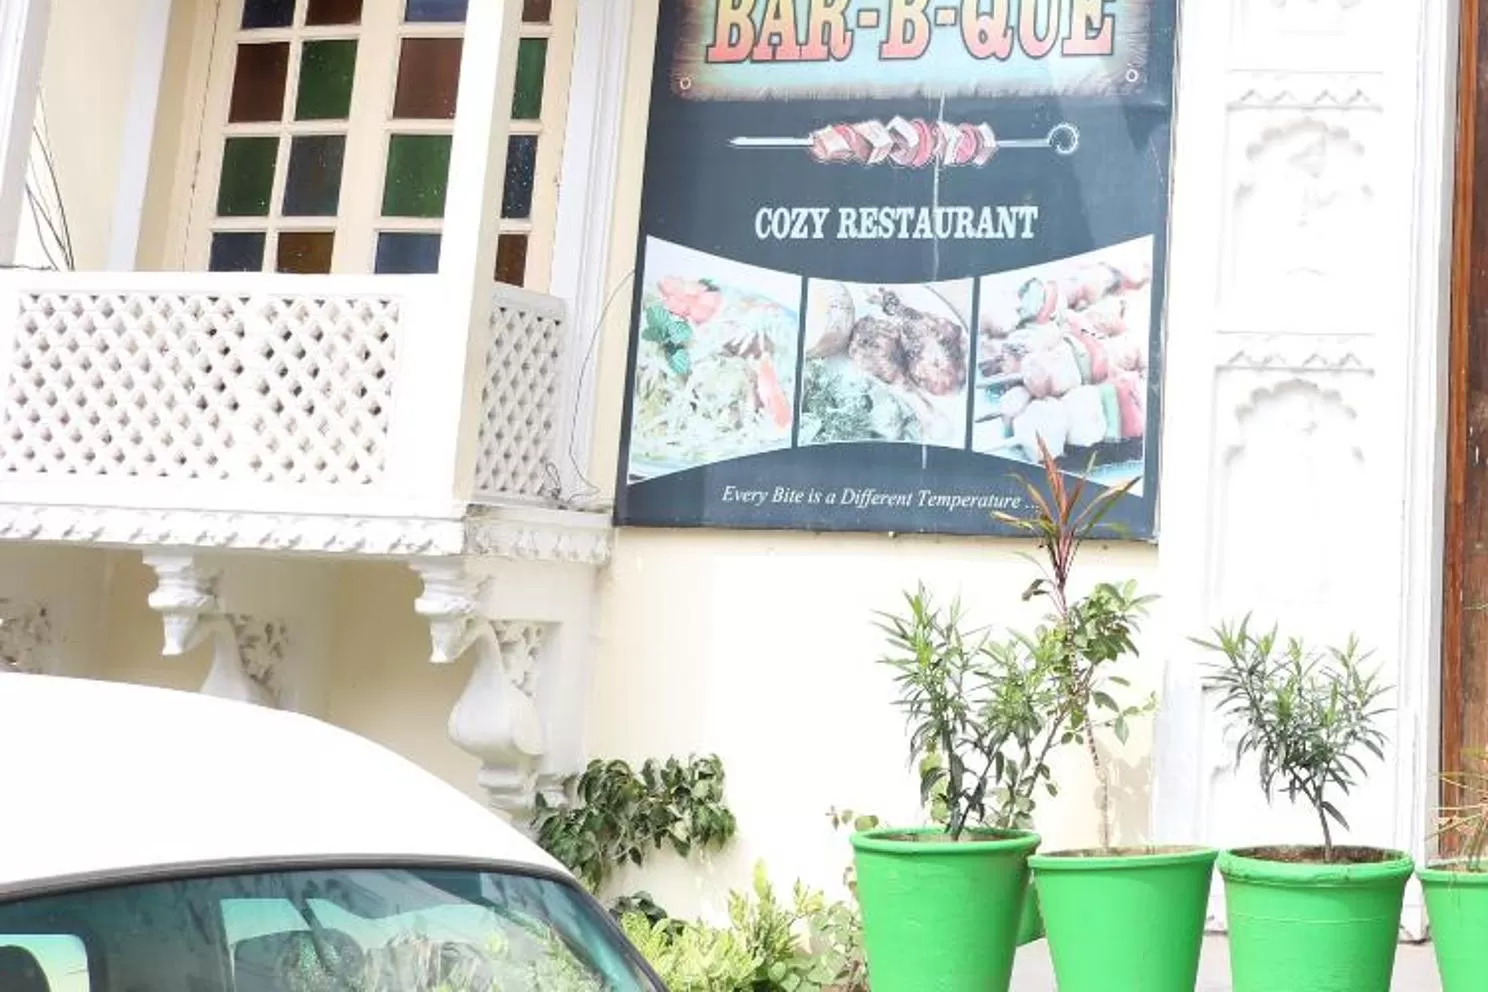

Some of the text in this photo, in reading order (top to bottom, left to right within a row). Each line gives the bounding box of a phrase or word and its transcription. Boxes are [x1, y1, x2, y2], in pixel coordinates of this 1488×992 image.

[754, 205, 1039, 240] COZY RESTAURANT
[722, 486, 769, 506] Every
[772, 487, 803, 503] Bite
[808, 487, 822, 504] is
[825, 490, 836, 505] a
[840, 488, 912, 509] Different
[917, 489, 1021, 511] Temperature
